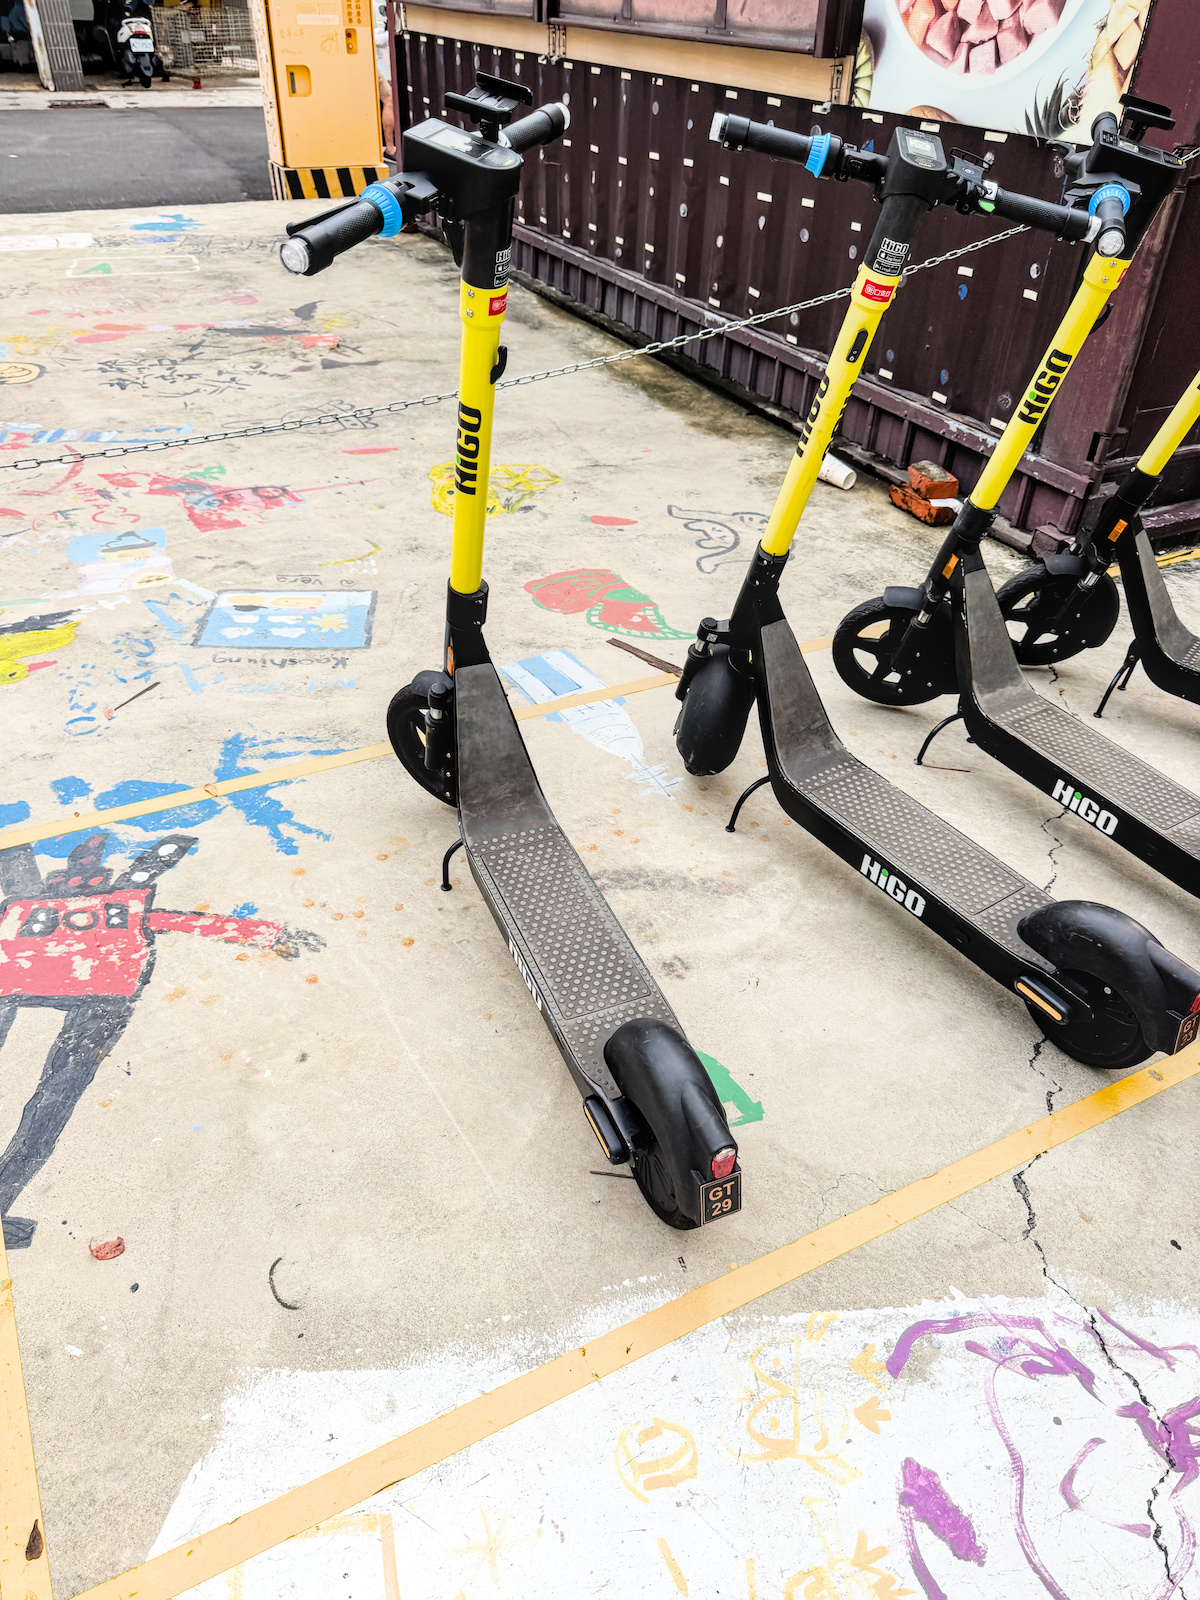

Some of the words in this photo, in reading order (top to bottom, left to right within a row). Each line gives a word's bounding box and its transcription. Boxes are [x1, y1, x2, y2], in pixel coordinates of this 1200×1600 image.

[1018, 349, 1073, 425] HiGO
[455, 401, 481, 495] HiGO
[1051, 778, 1119, 836] HiGO
[860, 854, 926, 917] HiGO
[1183, 1015, 1200, 1033] GT
[709, 1181, 735, 1201] GT
[711, 1198, 732, 1217] 29
